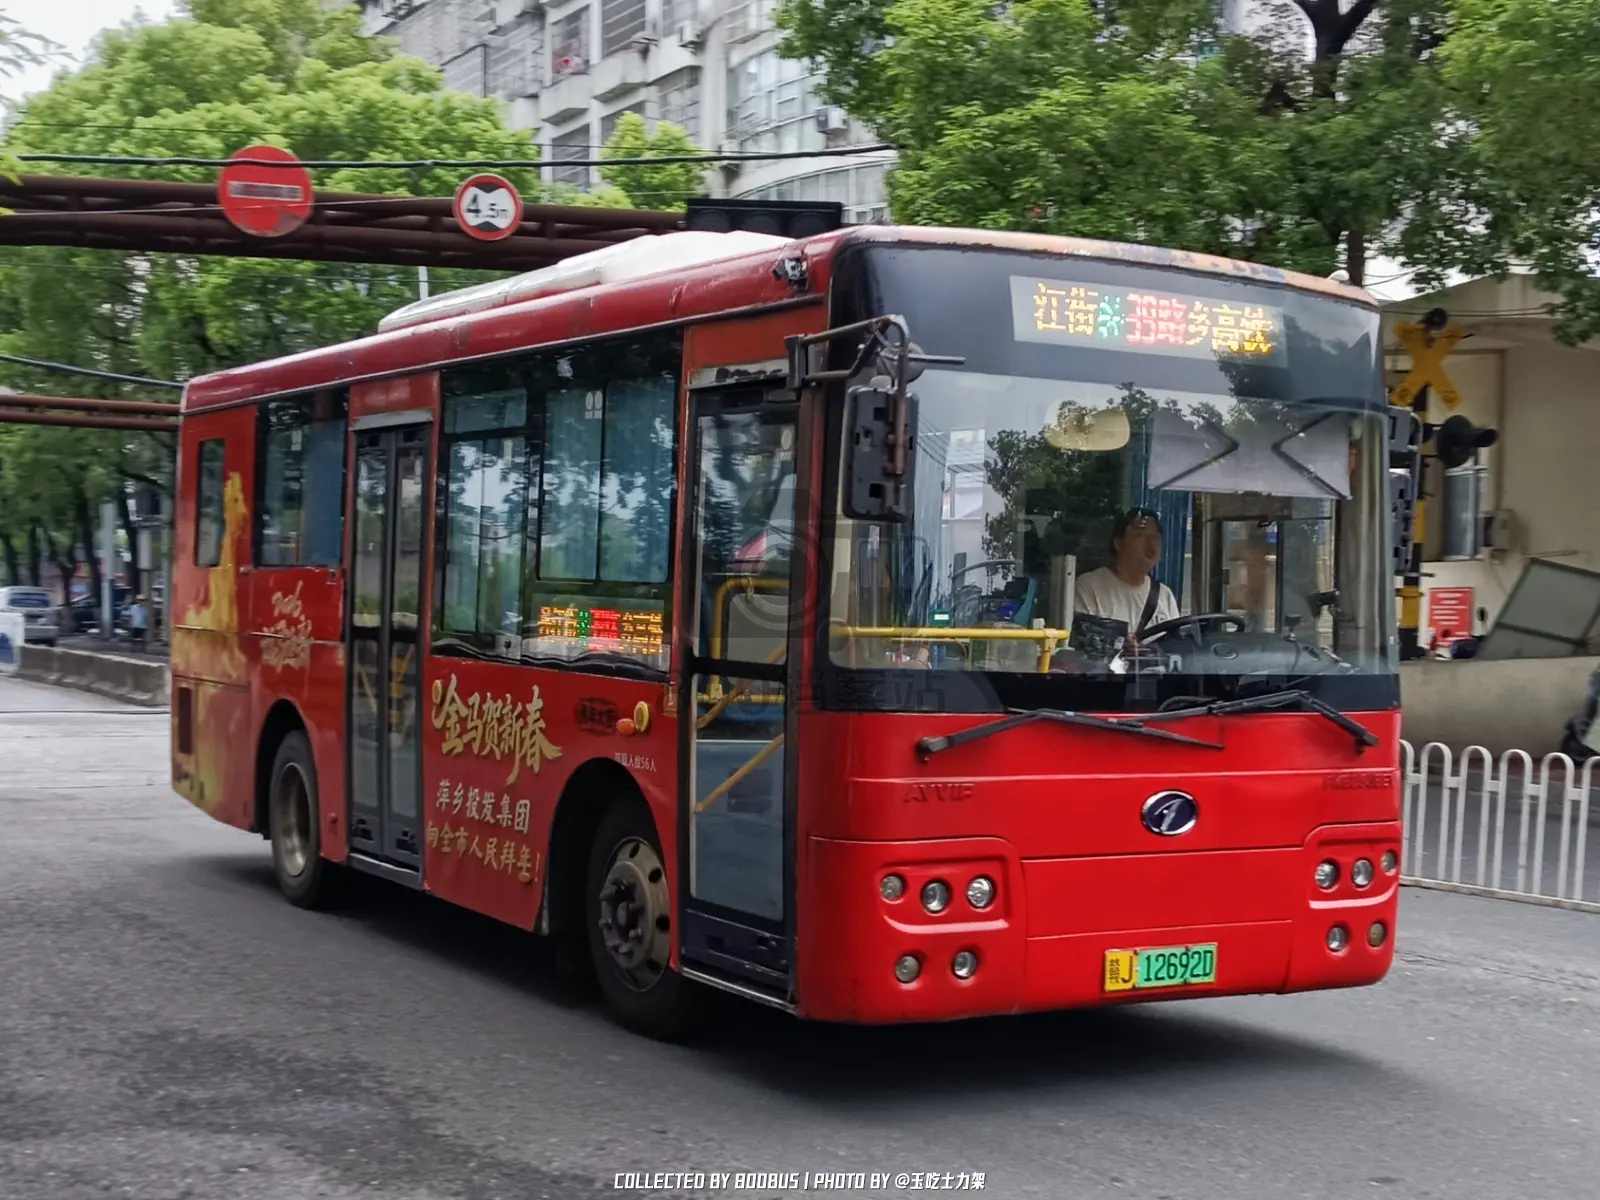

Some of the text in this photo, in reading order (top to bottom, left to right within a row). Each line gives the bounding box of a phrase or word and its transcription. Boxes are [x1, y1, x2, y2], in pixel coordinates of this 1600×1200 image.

[431, 673, 563, 786] 金马贺新春
[436, 779, 531, 833] 萍乡投发集团
